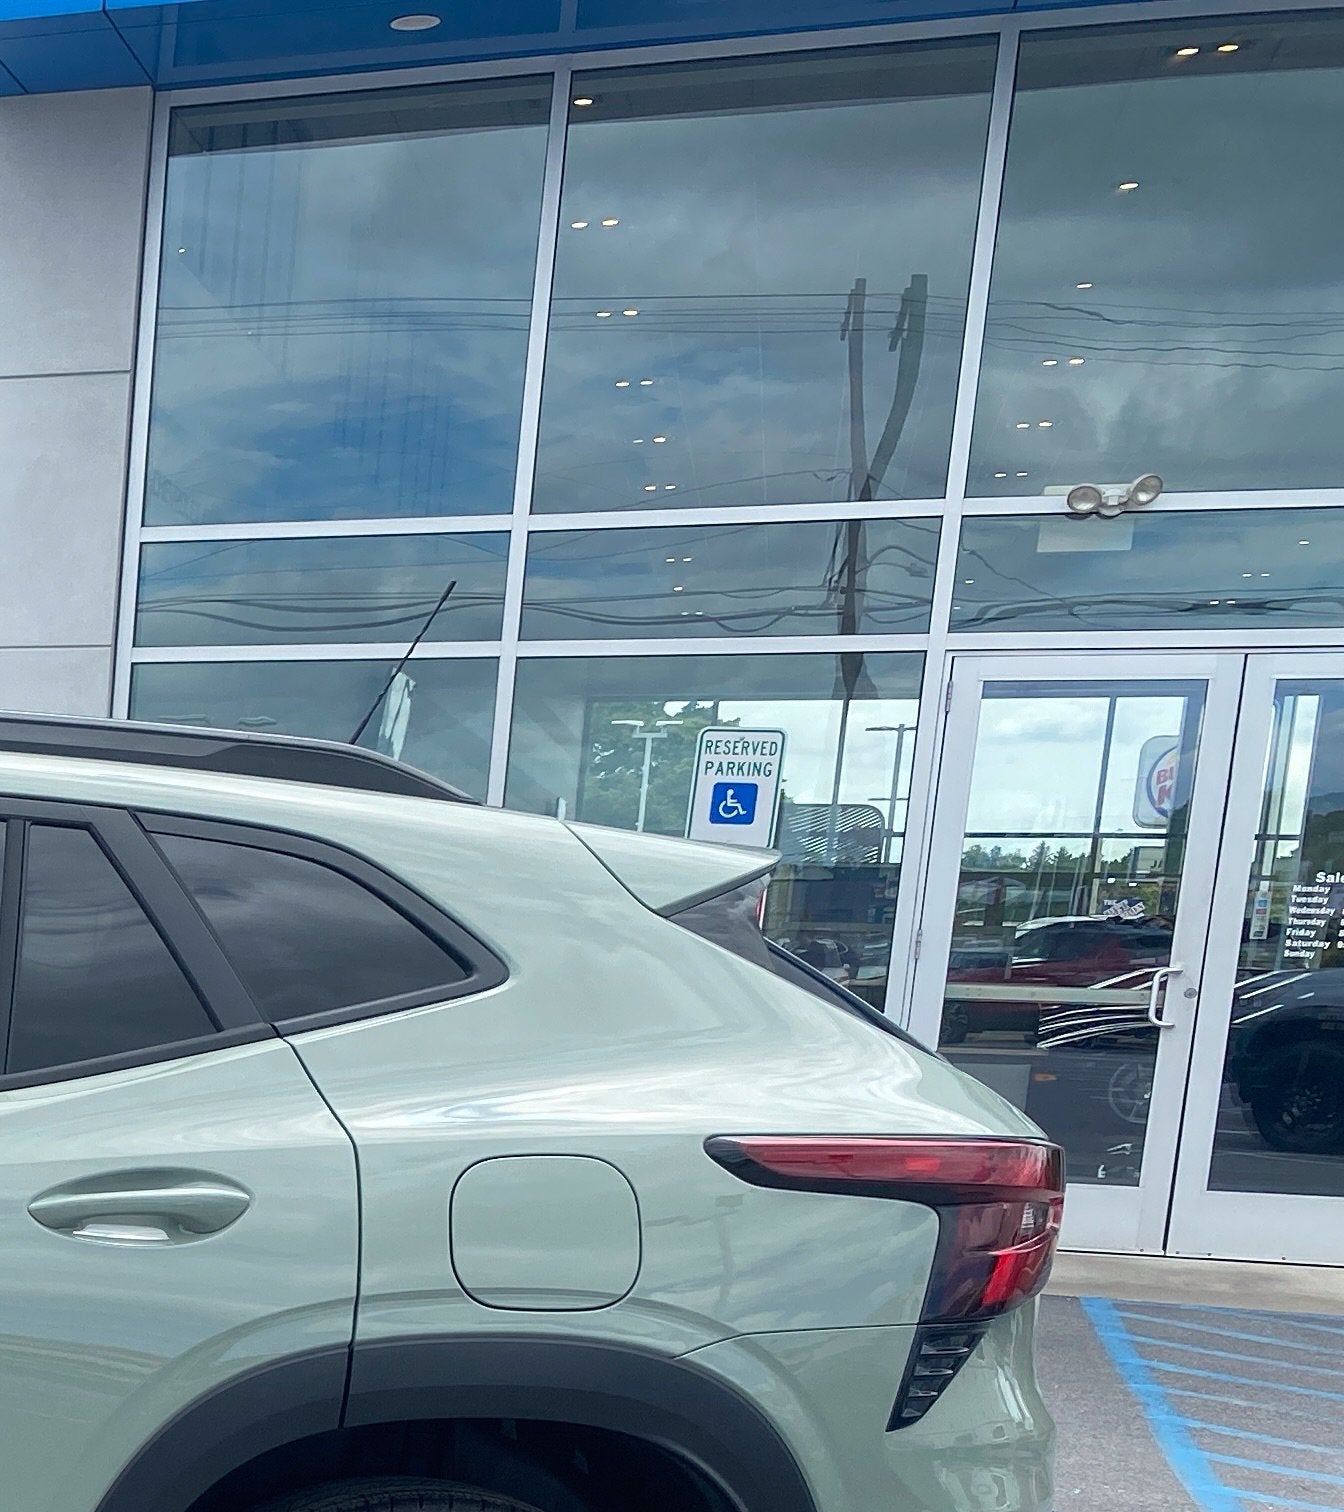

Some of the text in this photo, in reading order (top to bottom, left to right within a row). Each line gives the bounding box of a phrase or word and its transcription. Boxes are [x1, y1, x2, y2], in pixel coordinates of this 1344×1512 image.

[704, 739, 778, 756] RESERVED
[704, 761, 773, 777] PARKING
[1292, 884, 1331, 895] Monday
[1291, 894, 1330, 905] Tuesday
[1288, 905, 1336, 916] Wednesday
[1288, 917, 1327, 927] Thursday
[1285, 927, 1317, 938] Friday
[1284, 939, 1331, 950] Saturday
[1283, 949, 1315, 959] Sunday
